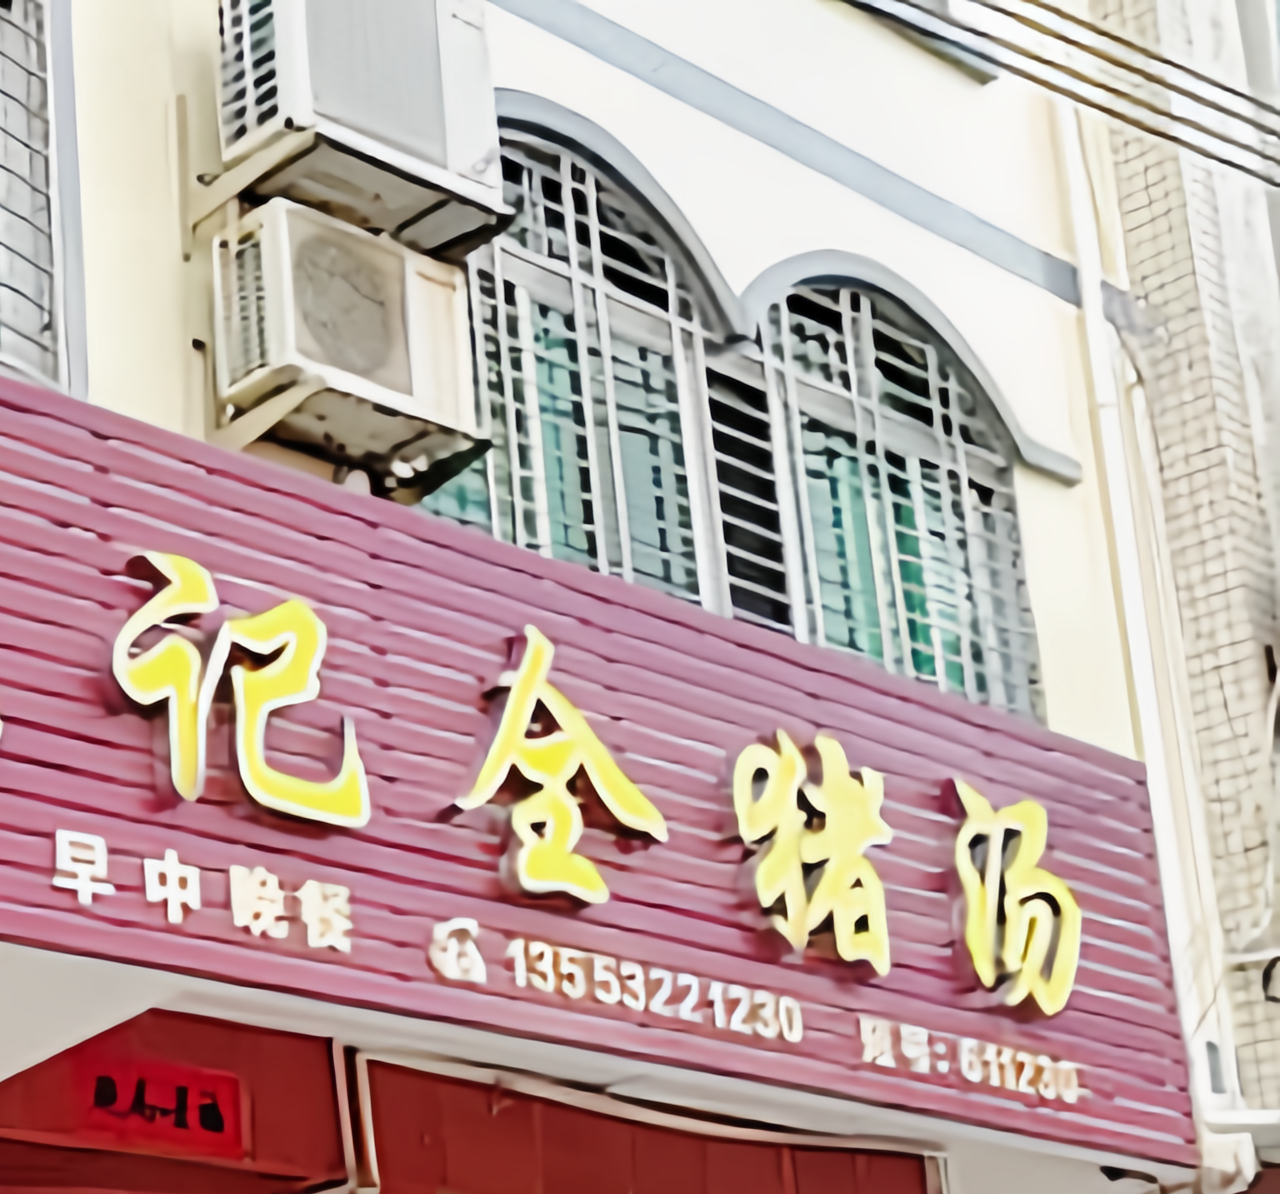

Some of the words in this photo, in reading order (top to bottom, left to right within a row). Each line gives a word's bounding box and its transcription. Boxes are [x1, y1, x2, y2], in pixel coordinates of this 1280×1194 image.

[51, 828, 354, 954] 早中晚餐
[504, 937, 804, 1044] 13553221230
